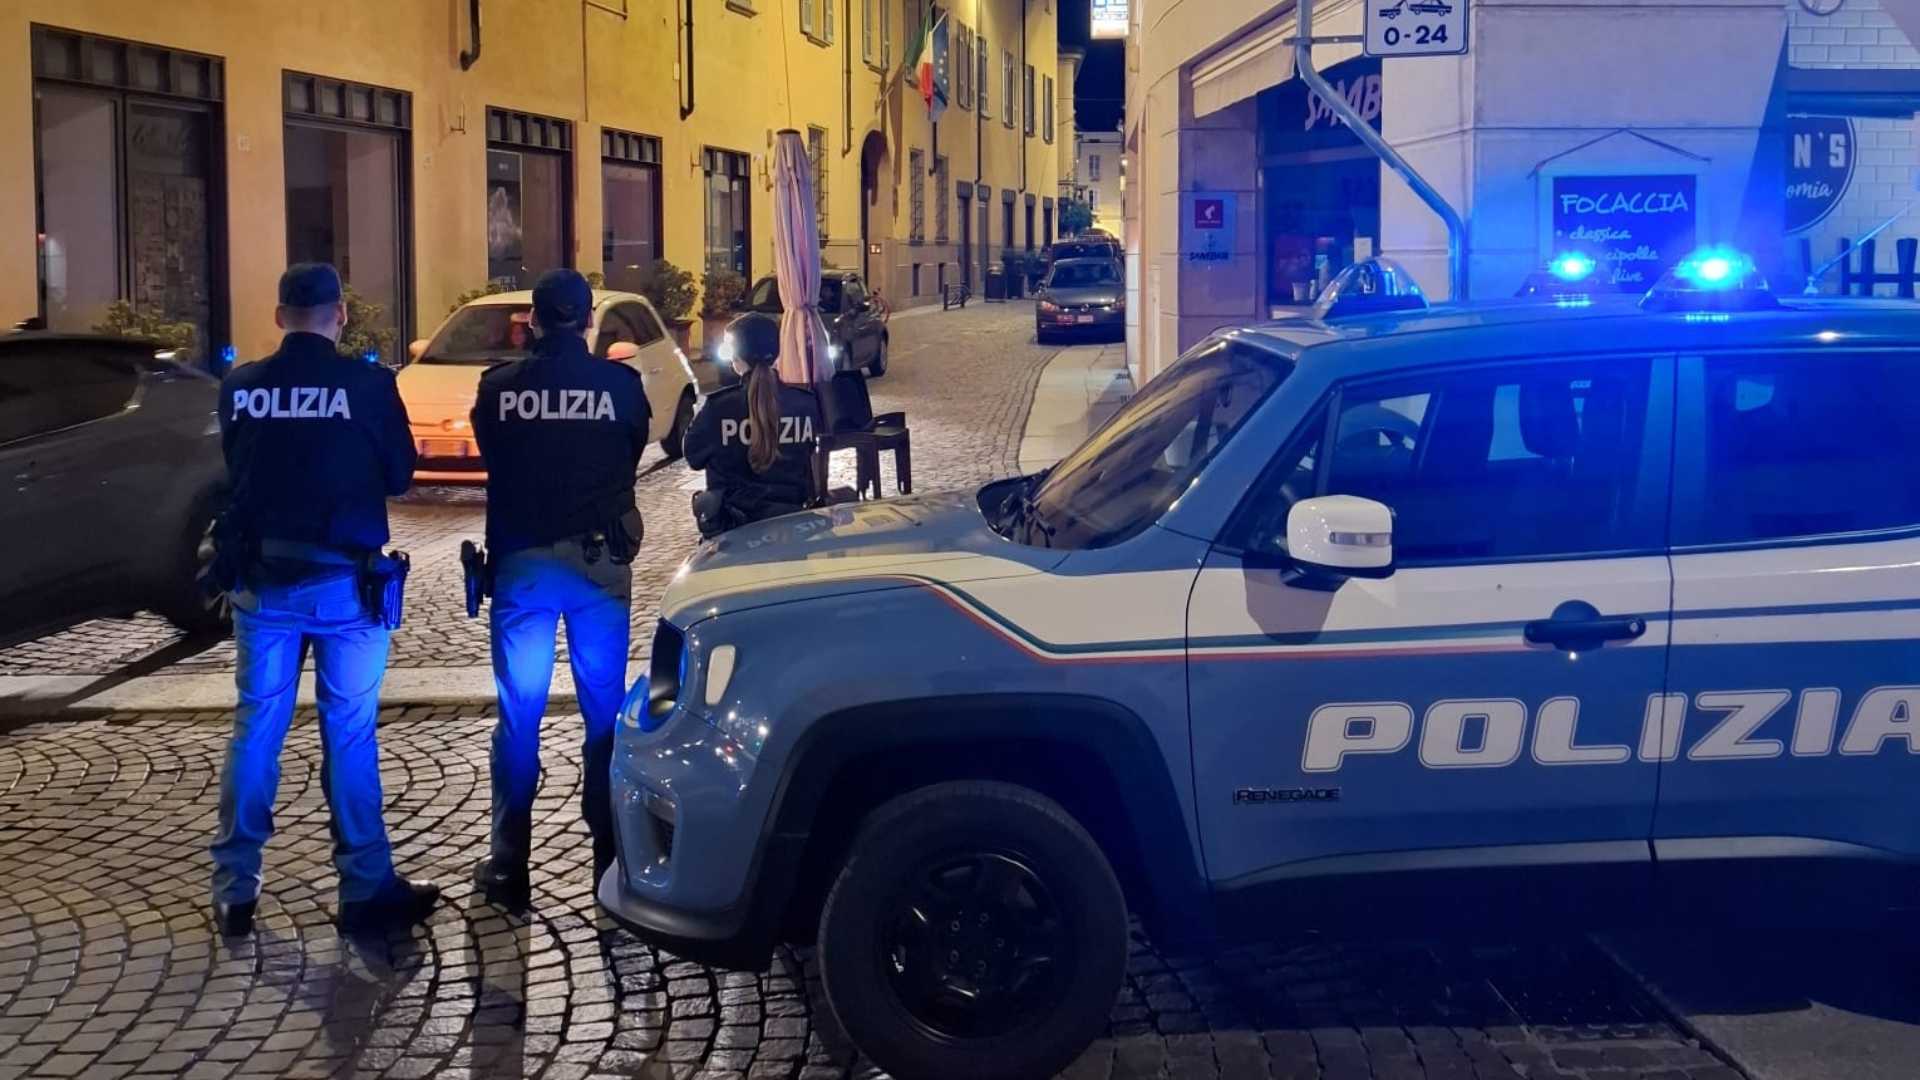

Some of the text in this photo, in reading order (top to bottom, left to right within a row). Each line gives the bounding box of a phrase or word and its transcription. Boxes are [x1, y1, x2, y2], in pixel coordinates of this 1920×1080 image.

[1560, 191, 1688, 214] FOCACCIA
[1569, 225, 1632, 243] classica
[231, 387, 351, 421] POLIZIA
[499, 389, 616, 421] POLIZIA
[721, 415, 813, 446] POZIA
[1301, 685, 1920, 773] POLIZIA
[1233, 787, 1341, 804] RENEGADE
